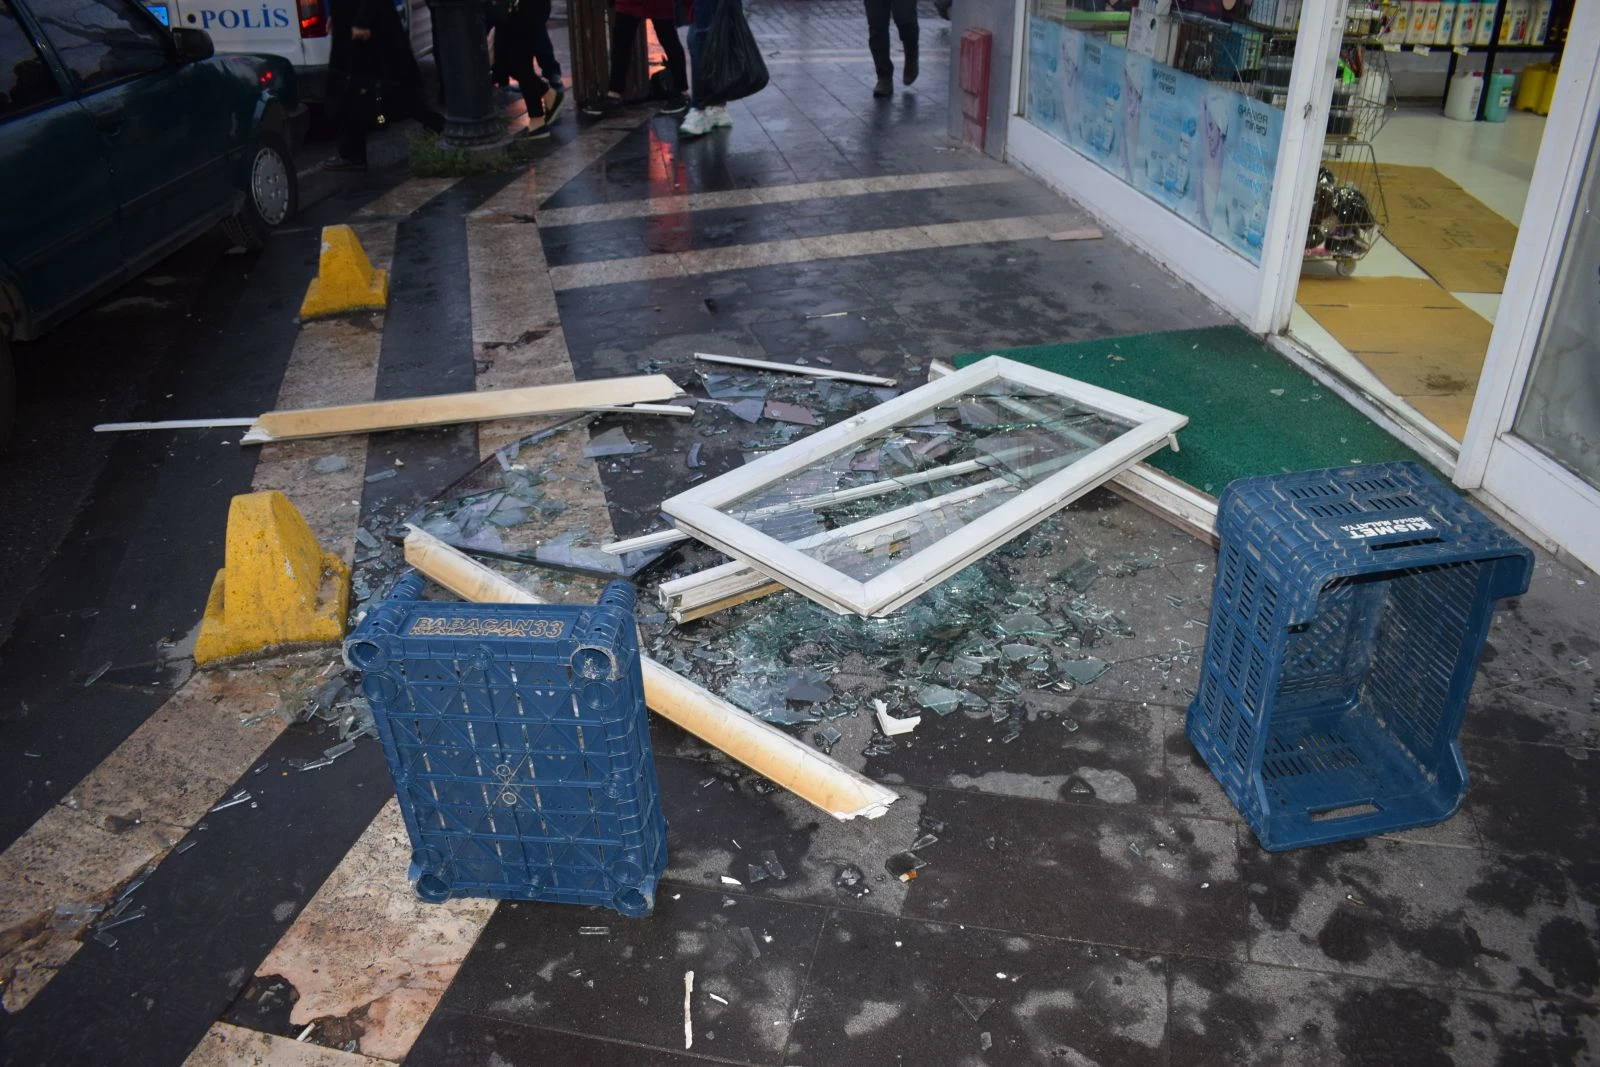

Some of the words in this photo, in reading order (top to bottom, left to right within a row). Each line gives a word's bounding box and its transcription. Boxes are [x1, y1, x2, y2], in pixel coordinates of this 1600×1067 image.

[200, 3, 289, 30] POLİS
[1341, 520, 1391, 531] MALATYA
[1349, 522, 1432, 538] KISMET
